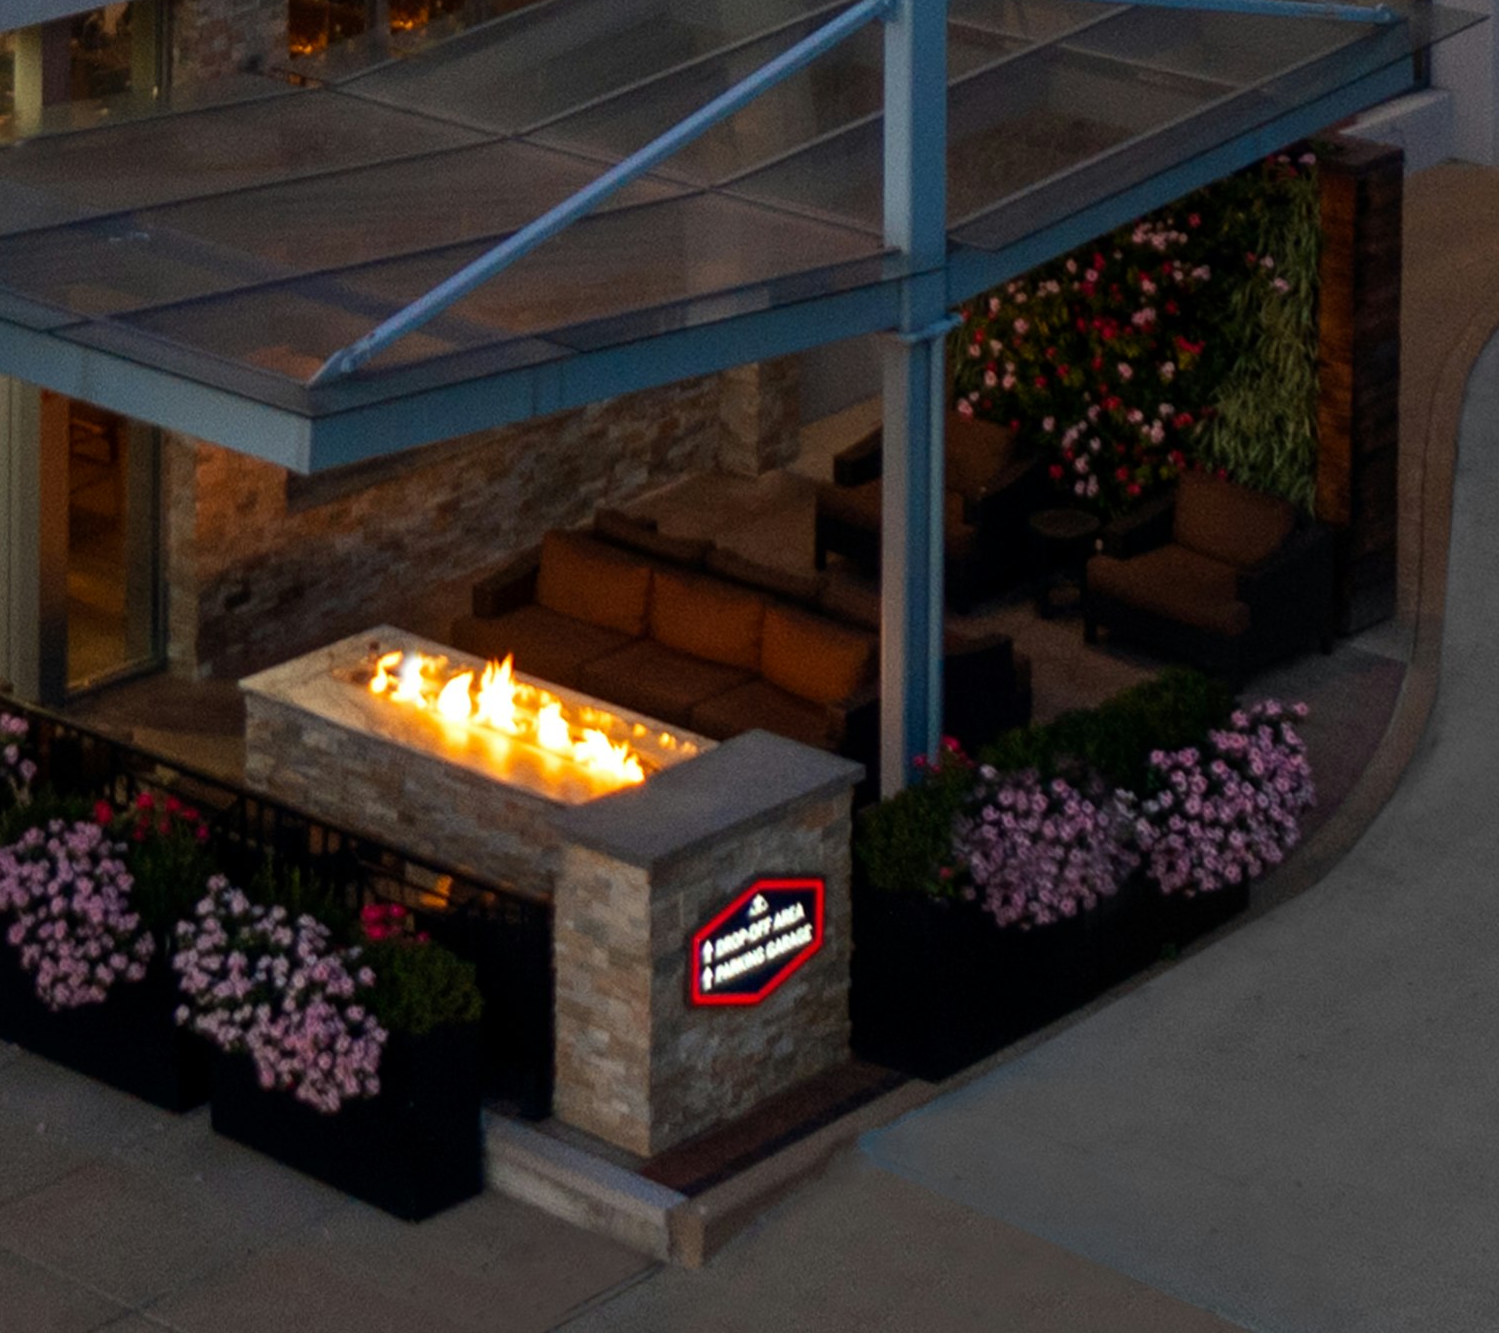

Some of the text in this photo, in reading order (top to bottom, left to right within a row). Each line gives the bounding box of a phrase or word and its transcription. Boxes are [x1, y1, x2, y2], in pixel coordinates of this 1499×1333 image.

[715, 901, 805, 959] DROP-OFF AREA
[715, 923, 813, 984] PARKING GARAGE
